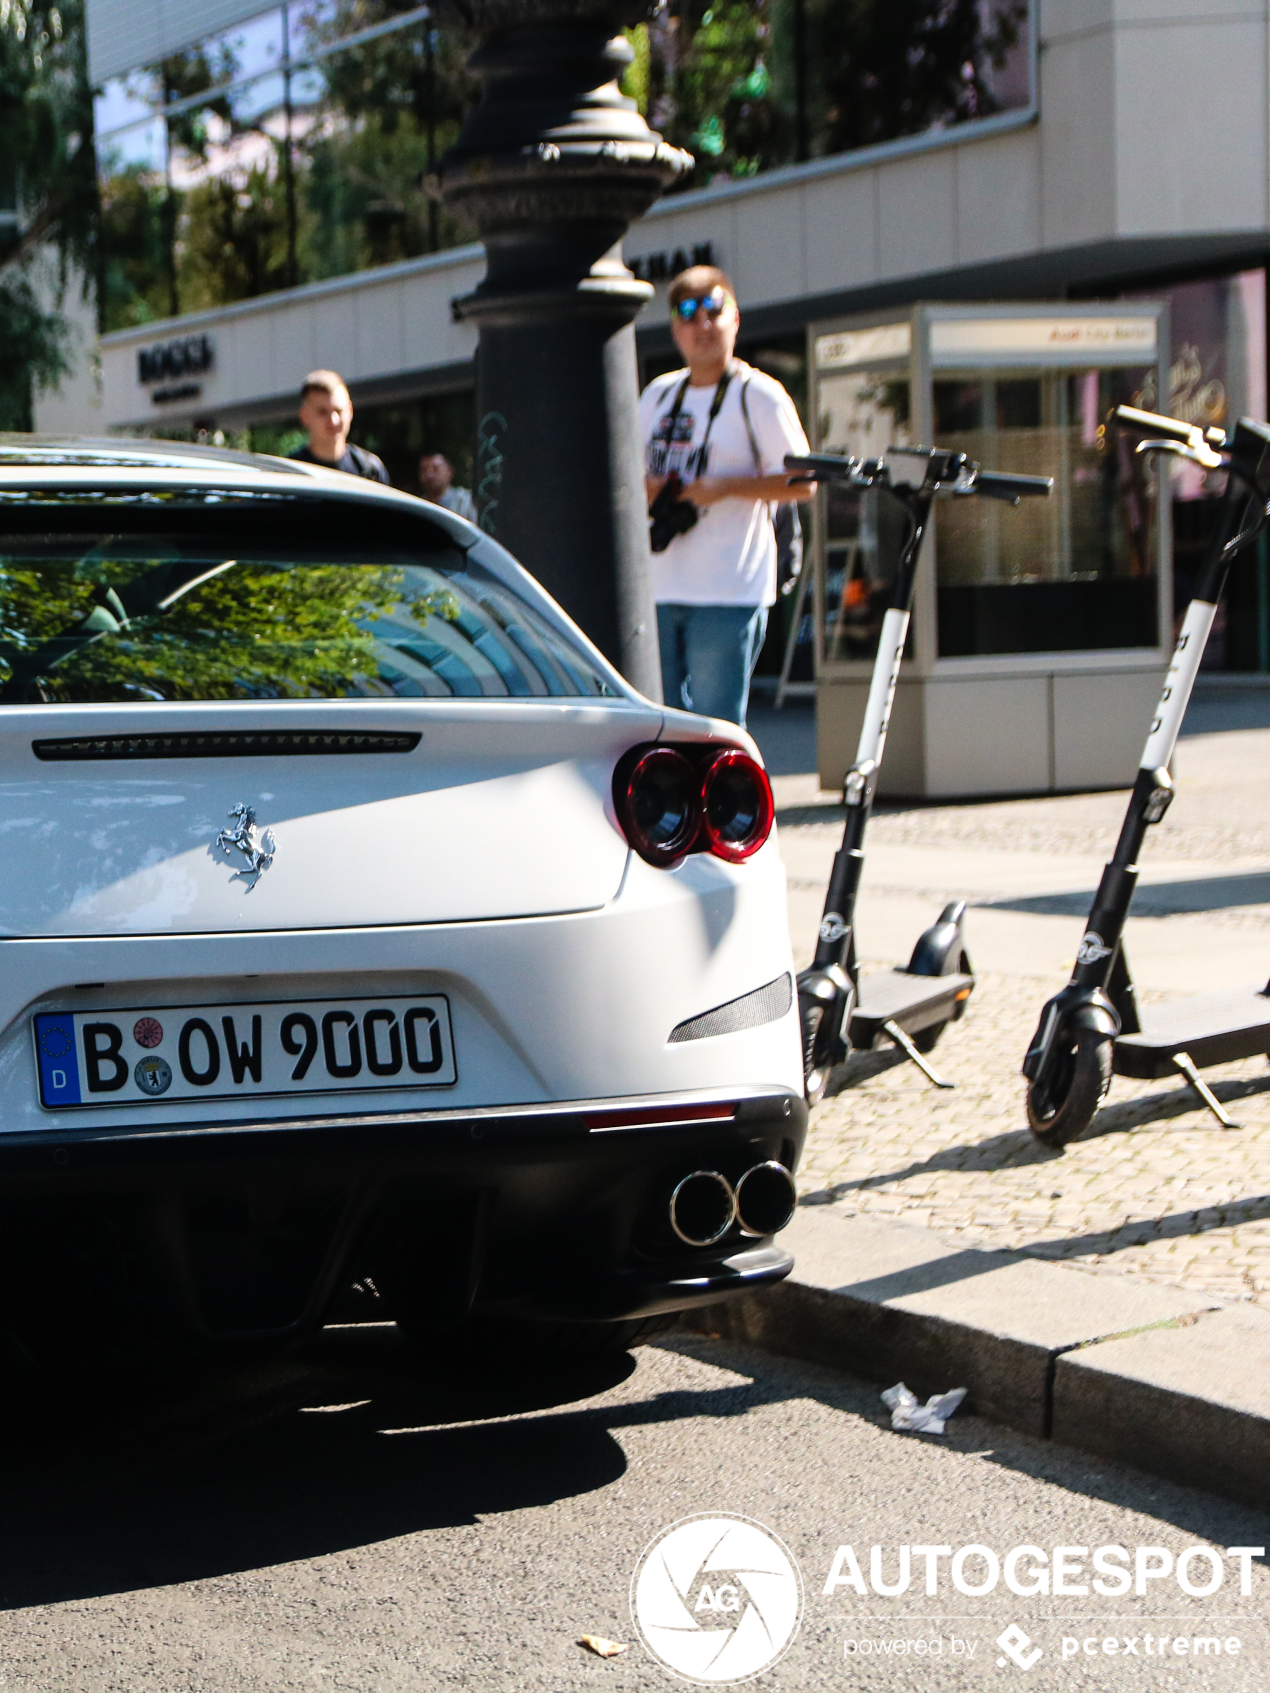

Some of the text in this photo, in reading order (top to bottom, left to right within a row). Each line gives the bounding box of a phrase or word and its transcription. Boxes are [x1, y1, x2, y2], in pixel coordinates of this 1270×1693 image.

[82, 1007, 444, 1092] B OW 9000
[52, 1069, 67, 1089] D
